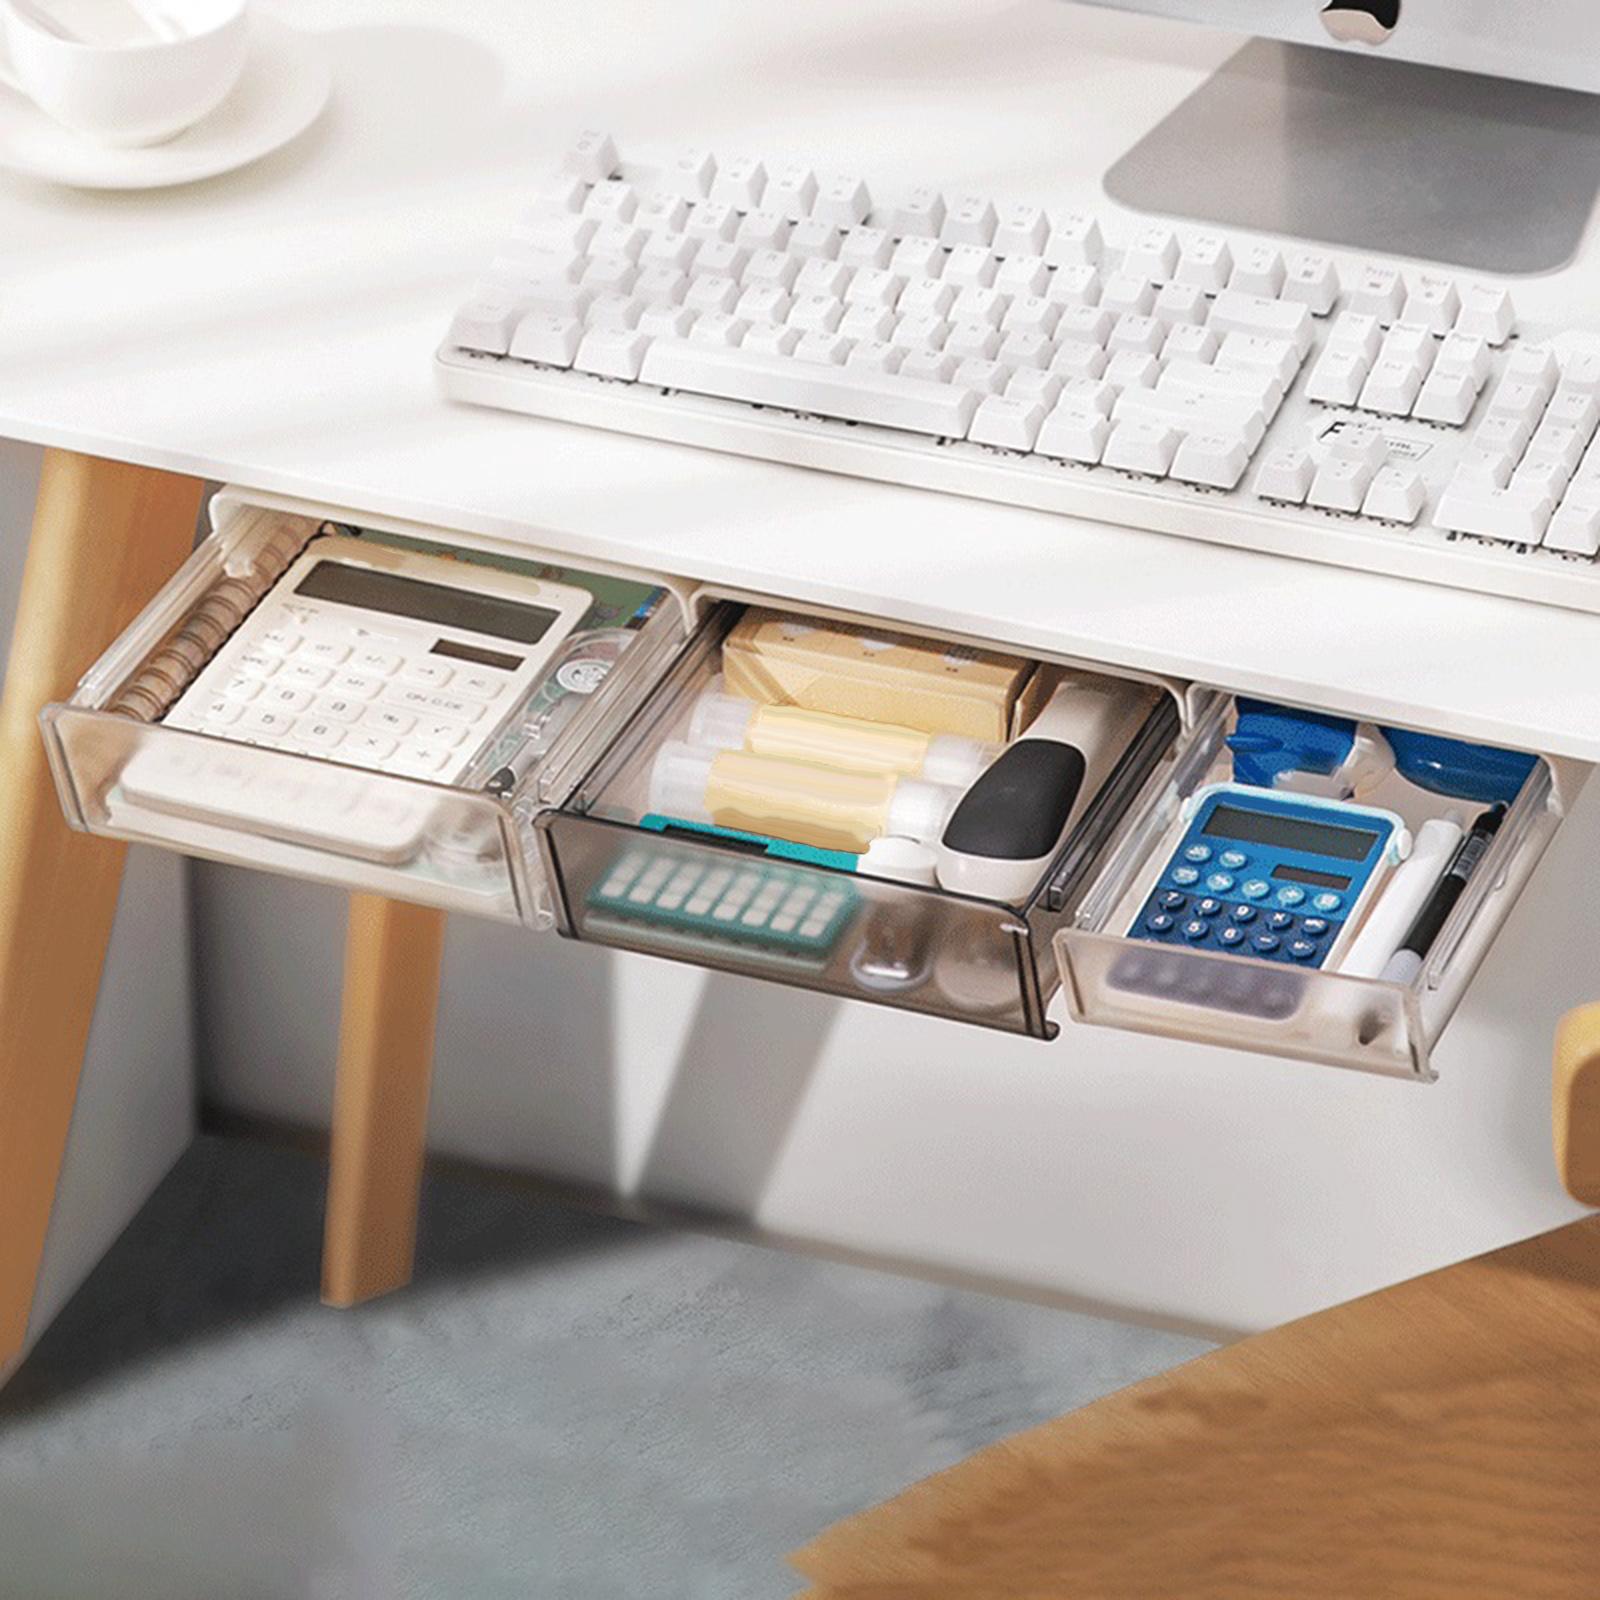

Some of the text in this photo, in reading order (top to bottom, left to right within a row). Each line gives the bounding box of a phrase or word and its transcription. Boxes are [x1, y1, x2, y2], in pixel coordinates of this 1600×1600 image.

[1166, 892, 1180, 901] 7
[1201, 898, 1215, 909] 8
[1236, 906, 1249, 916] 9
[1188, 922, 1201, 932] 5
[1223, 928, 1236, 939] 6
